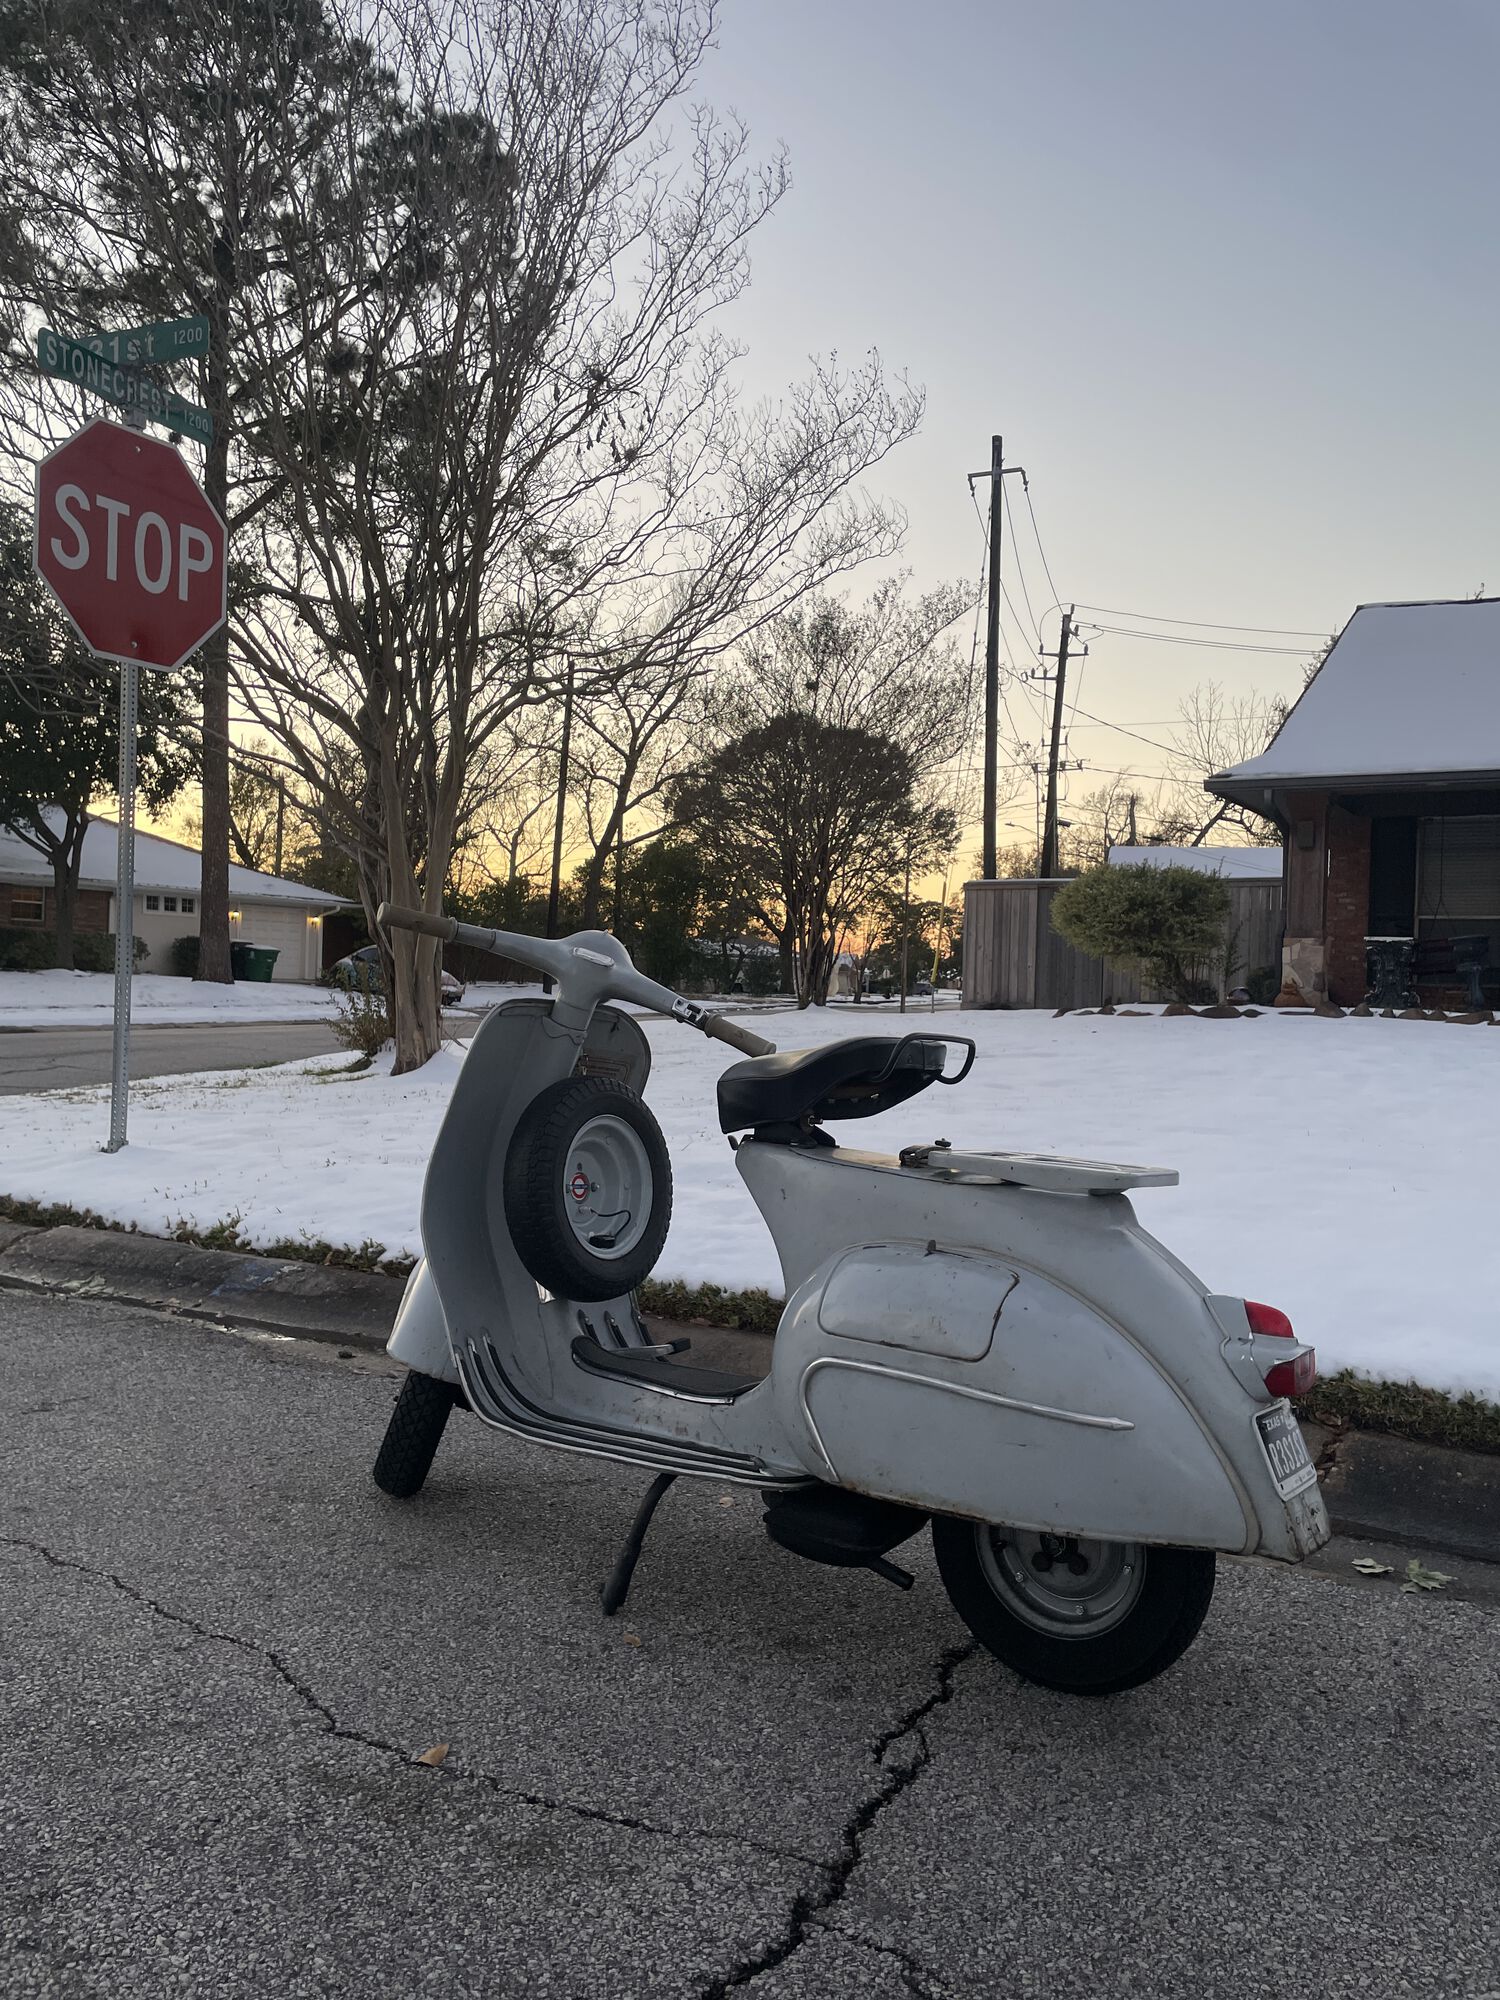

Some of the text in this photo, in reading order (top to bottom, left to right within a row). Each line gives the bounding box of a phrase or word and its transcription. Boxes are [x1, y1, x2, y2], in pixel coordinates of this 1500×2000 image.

[174, 327, 203, 345] 1200
[46, 335, 209, 433] STONECREST 1200
[51, 483, 213, 601] STOP
[1262, 1416, 1281, 1431] TEXAS
[1268, 1429, 1309, 1478] R3S1ST
